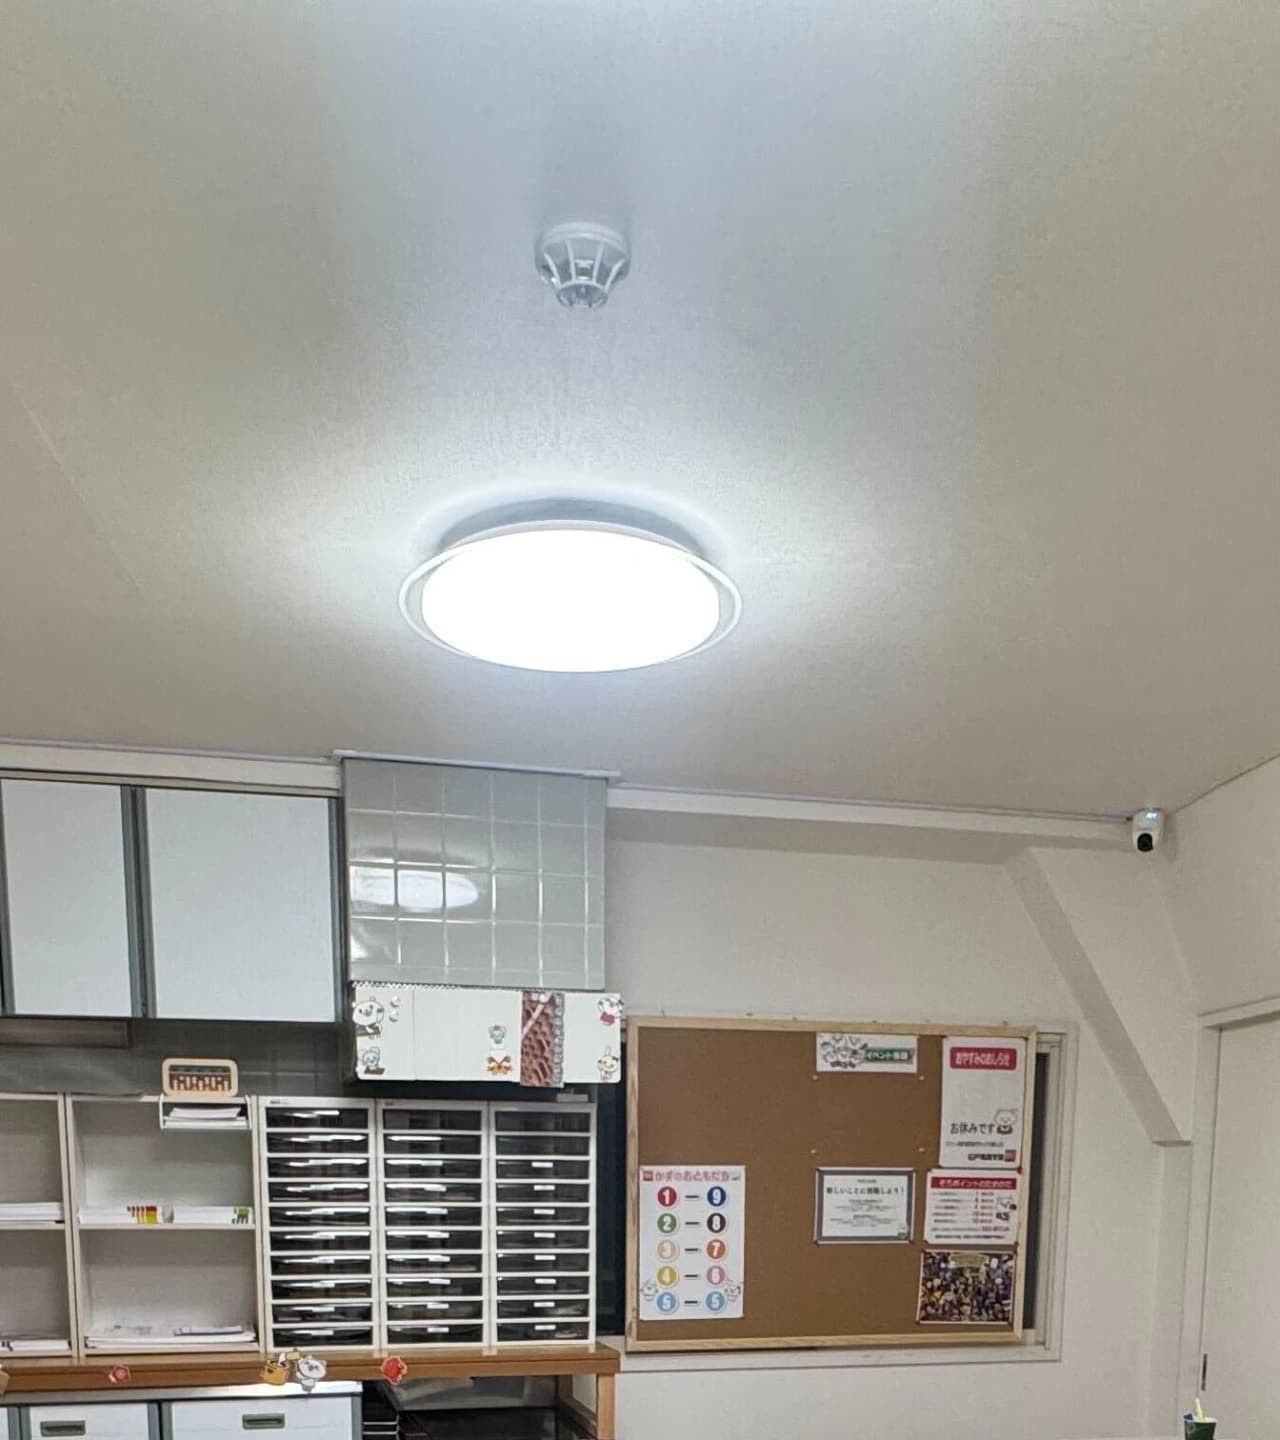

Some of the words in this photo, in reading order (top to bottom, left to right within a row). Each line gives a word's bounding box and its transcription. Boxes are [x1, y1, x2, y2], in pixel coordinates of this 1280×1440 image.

[950, 1123, 995, 1135] お休みです
